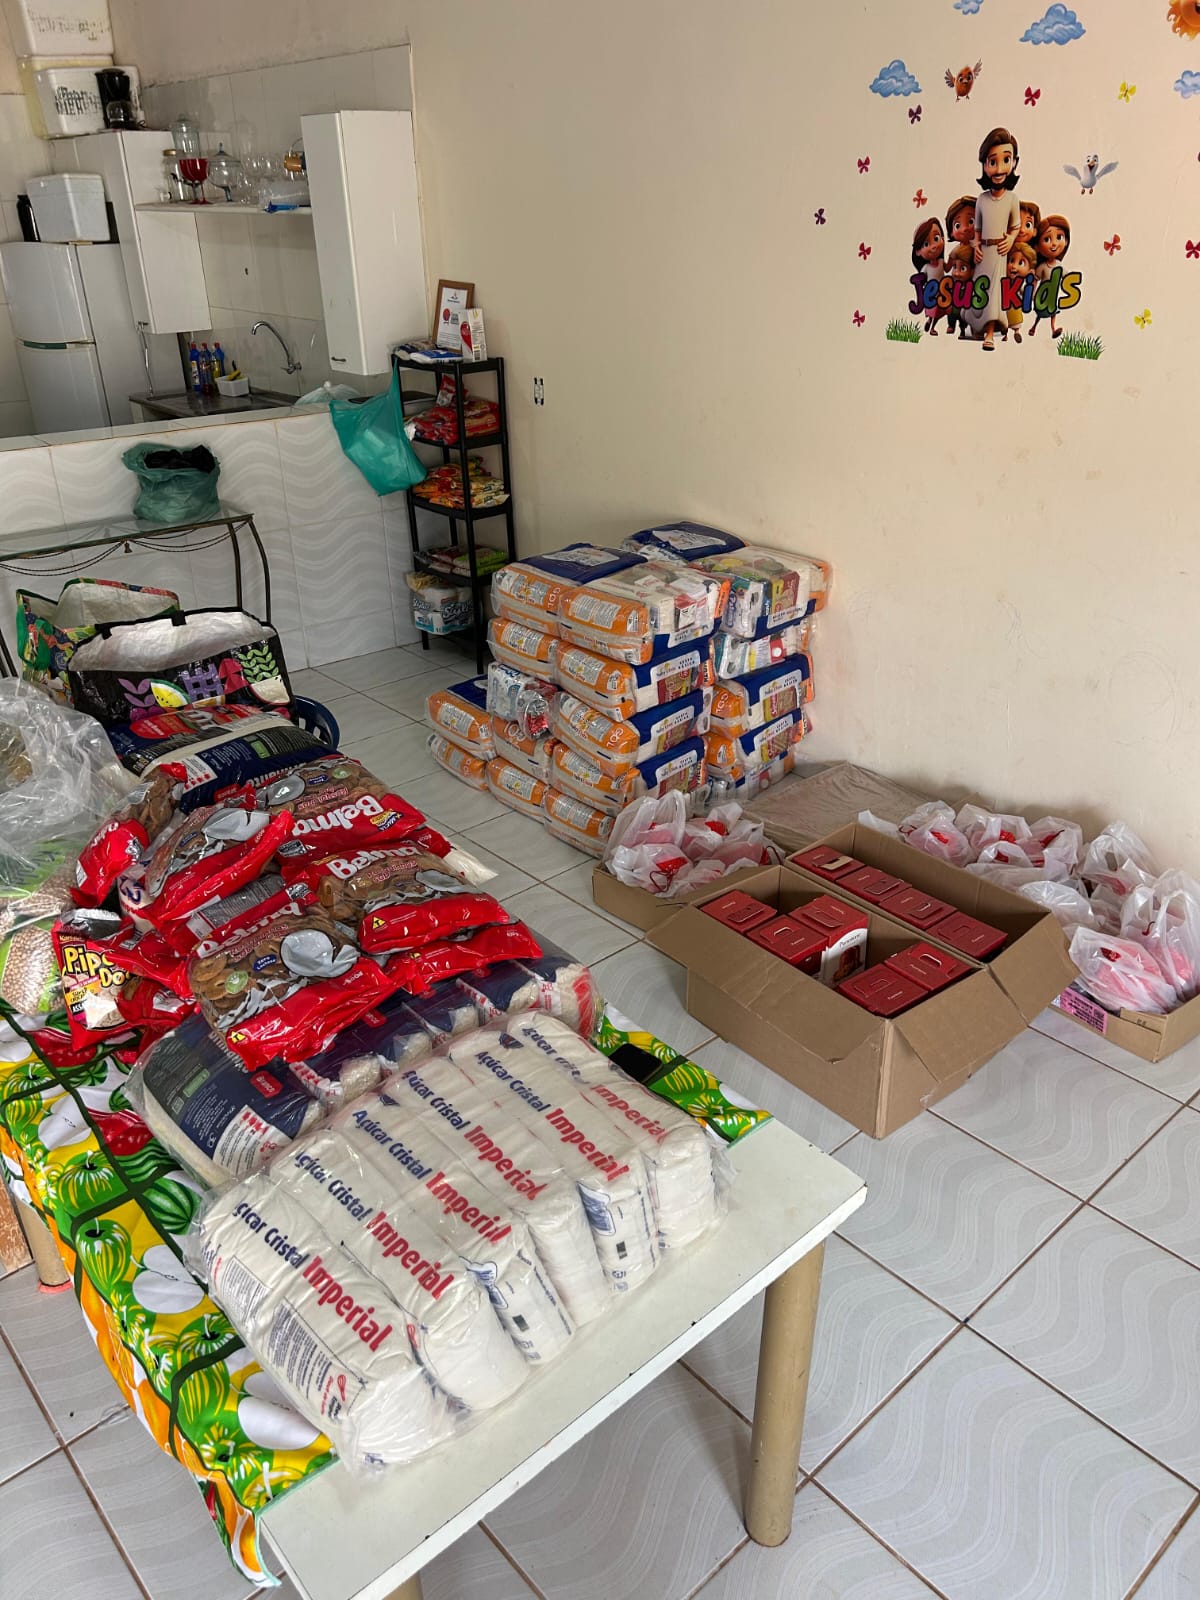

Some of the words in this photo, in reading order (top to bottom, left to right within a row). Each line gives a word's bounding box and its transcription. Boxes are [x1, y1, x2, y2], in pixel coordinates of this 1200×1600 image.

[908, 271, 991, 315] Jesus
[1000, 266, 1082, 314] Kids
[291, 795, 384, 836] Belma
[326, 846, 422, 880] Belma
[62, 945, 114, 977] Pipo
[352, 1109, 393, 1146] Açúcar
[387, 1141, 433, 1180] Cristal
[401, 1070, 435, 1101] çúcar
[429, 1096, 471, 1131] Cristal
[463, 1124, 549, 1201] Imperial
[474, 1050, 514, 1082] Açúcar
[508, 1078, 551, 1113] Cristal
[545, 1107, 630, 1182] Imperial
[326, 1179, 373, 1222] Cristal
[365, 1211, 455, 1301] Imperial
[263, 1228, 310, 1270] Cristal
[301, 1255, 393, 1353] Imperial
